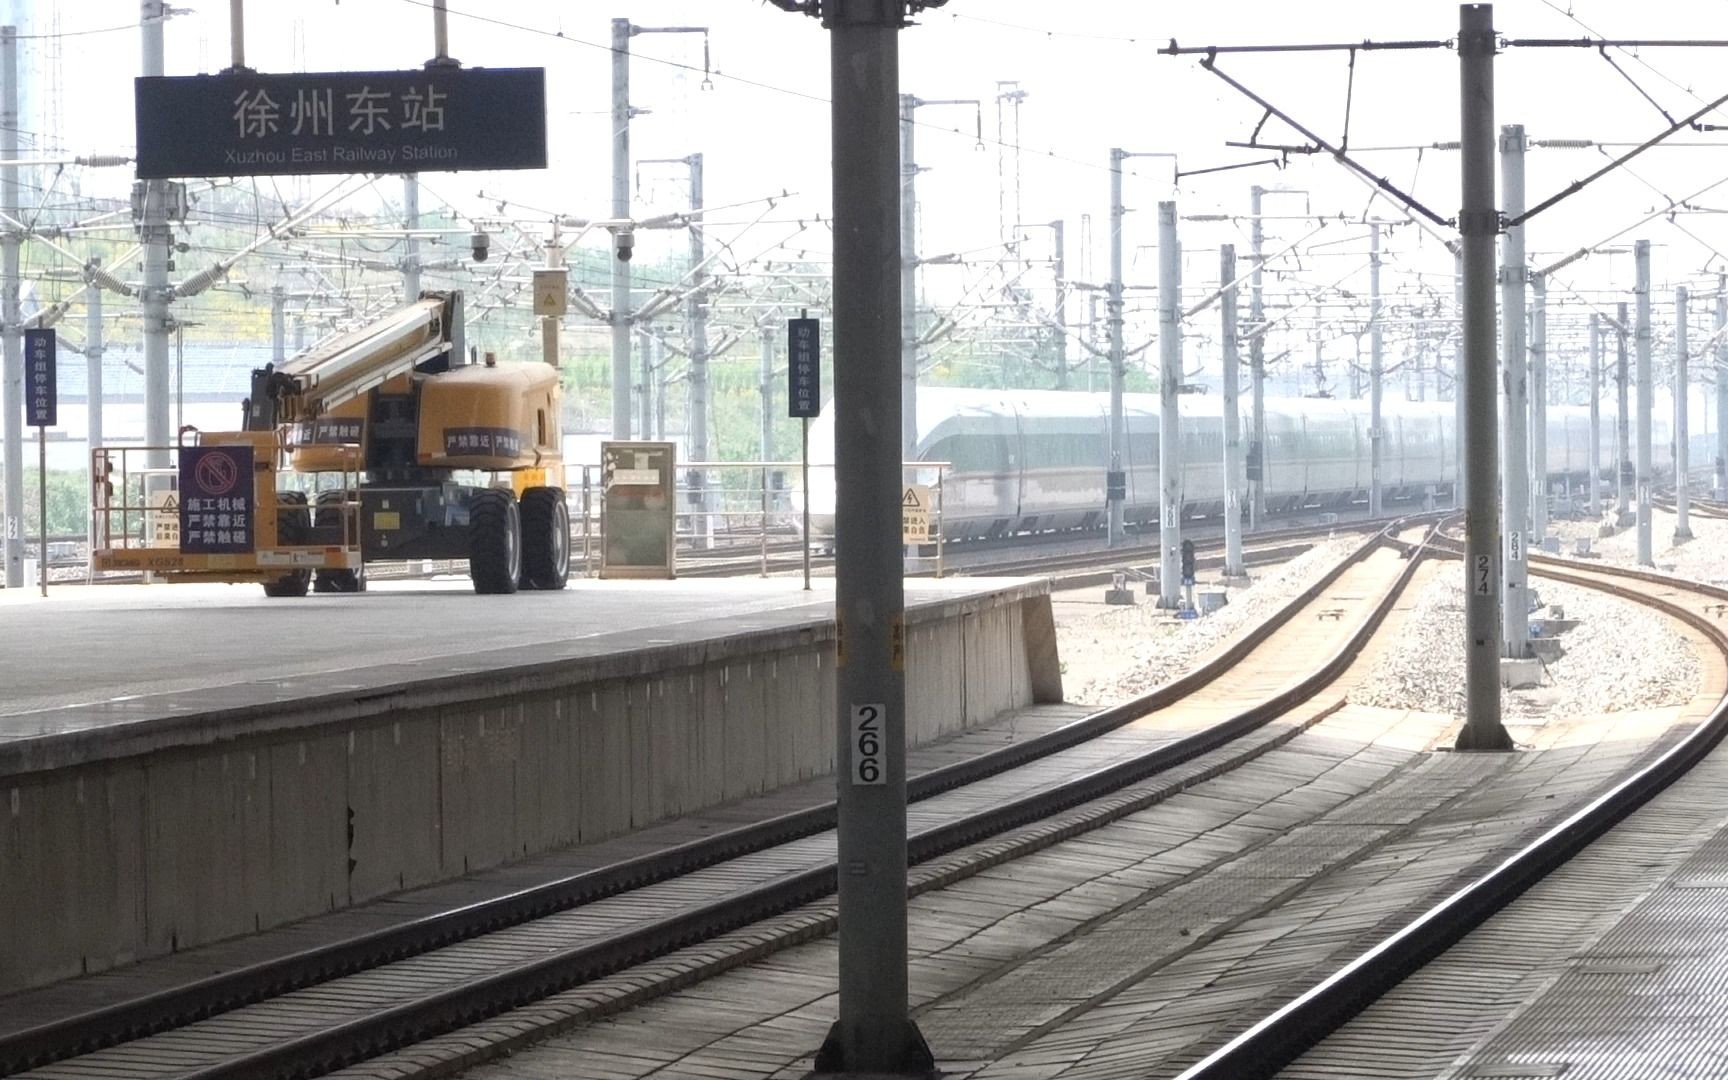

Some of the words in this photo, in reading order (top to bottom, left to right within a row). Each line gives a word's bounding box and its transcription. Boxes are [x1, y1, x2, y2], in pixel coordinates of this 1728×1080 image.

[233, 84, 447, 138] 徐州东站
[224, 148, 286, 164] Xuzhou
[291, 147, 327, 162] East
[333, 146, 397, 163] Railway
[402, 144, 458, 160] Station
[34, 336, 48, 420] 动车组停车位置
[187, 497, 246, 511] 施工机械
[156, 523, 178, 531] 严禁进
[187, 514, 246, 528] 严禁靠近
[903, 516, 926, 525] 禁进入
[156, 532, 178, 541] 后果自
[187, 530, 247, 544] 严禁触碰
[903, 526, 925, 534] 果自负
[1511, 531, 1519, 560] 284
[1478, 556, 1489, 594] 274
[858, 706, 880, 782] 266
